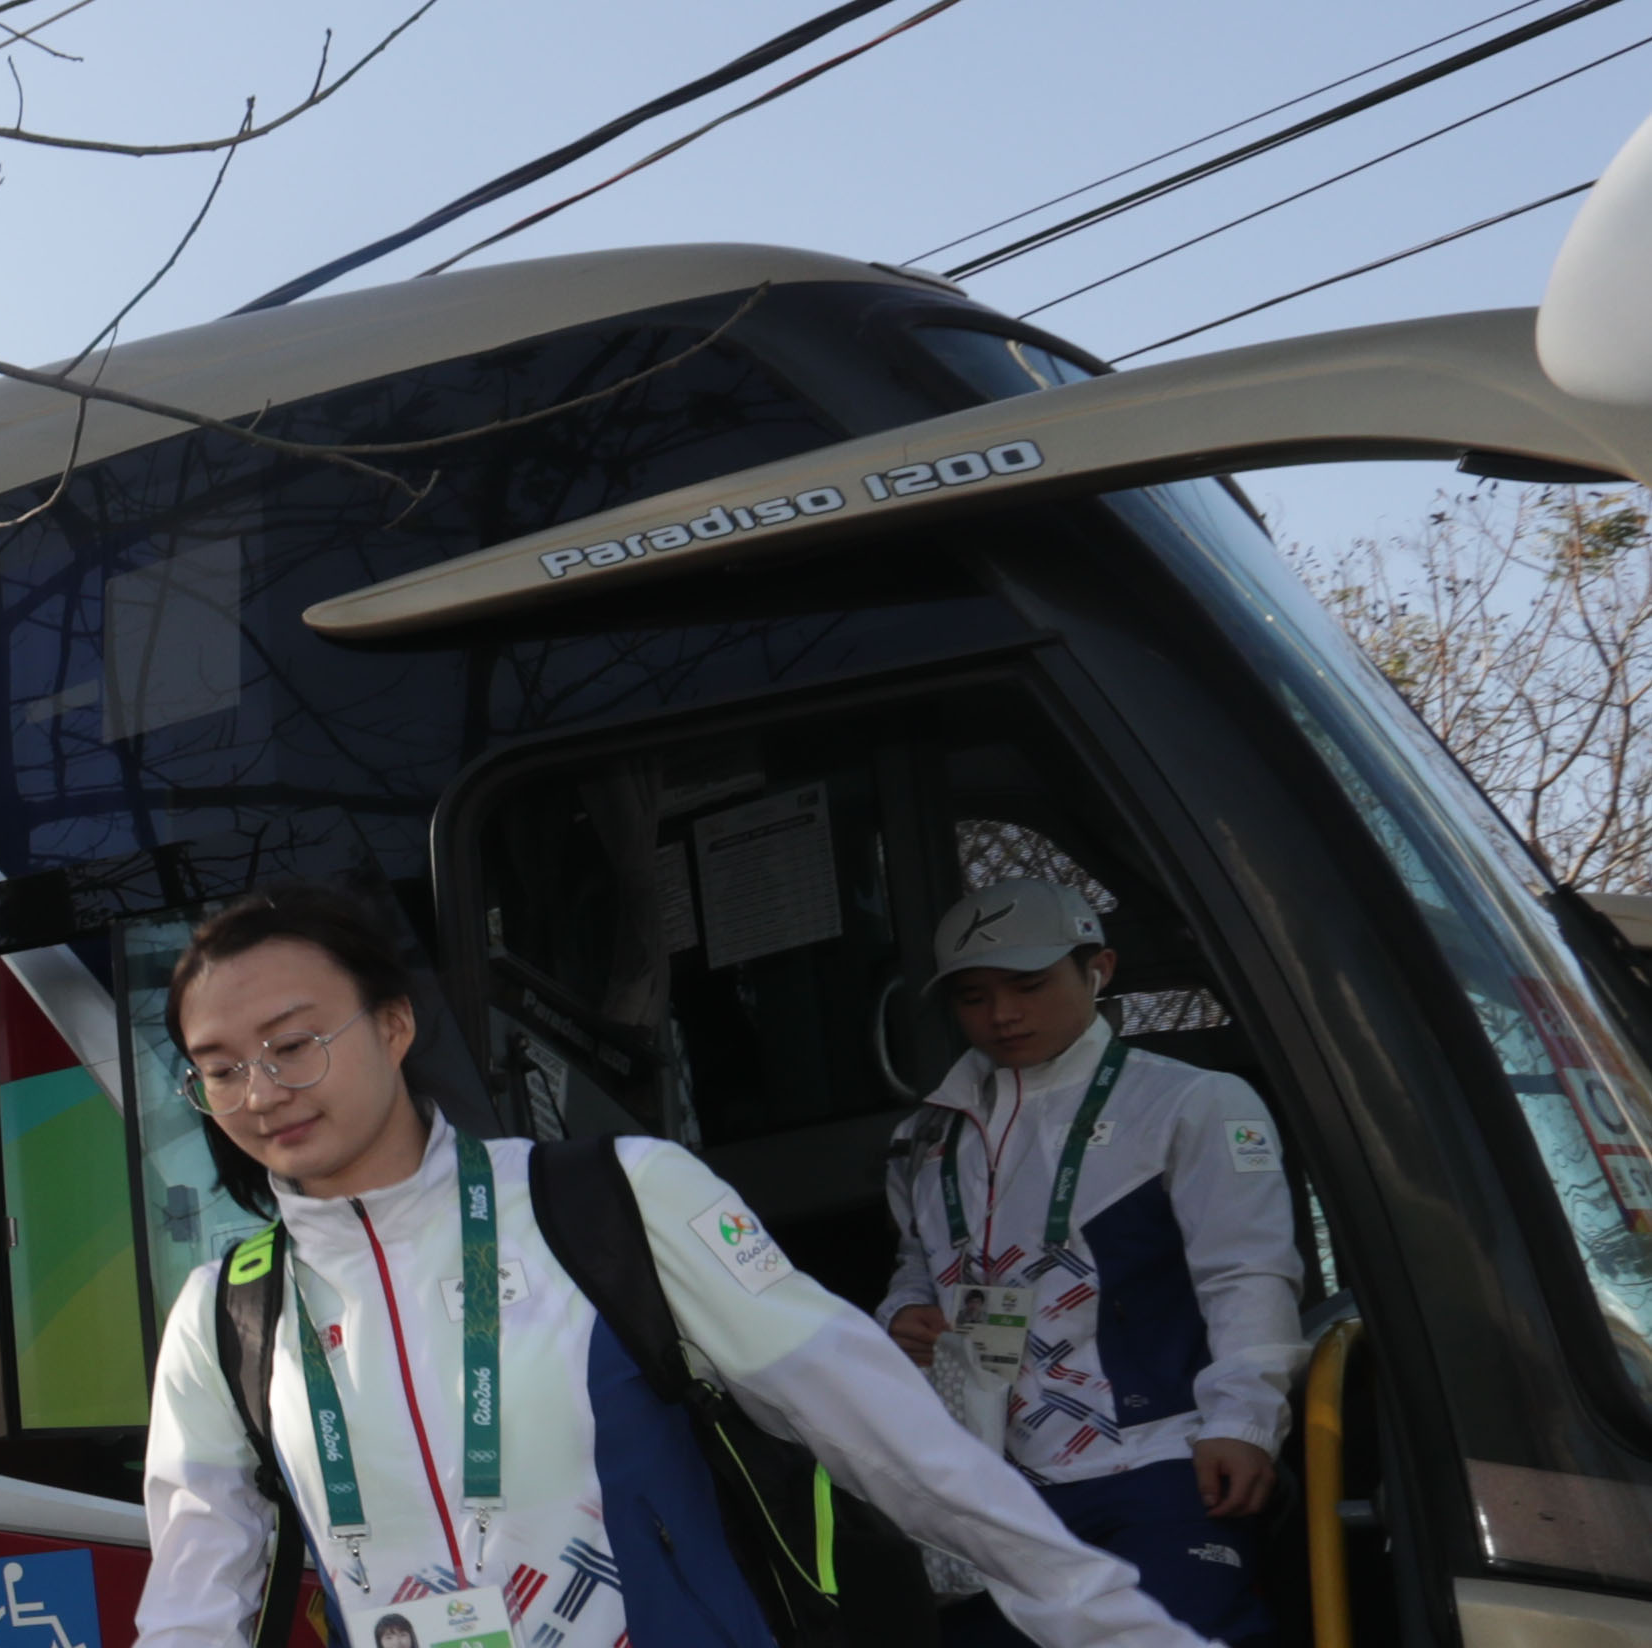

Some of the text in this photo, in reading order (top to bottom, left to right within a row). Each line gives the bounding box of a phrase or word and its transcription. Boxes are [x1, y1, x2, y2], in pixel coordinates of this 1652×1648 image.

[538, 439, 1044, 579] Paradiso 1200
[473, 1367, 491, 1425] Rio2016
[318, 1409, 343, 1461] Rio2016
